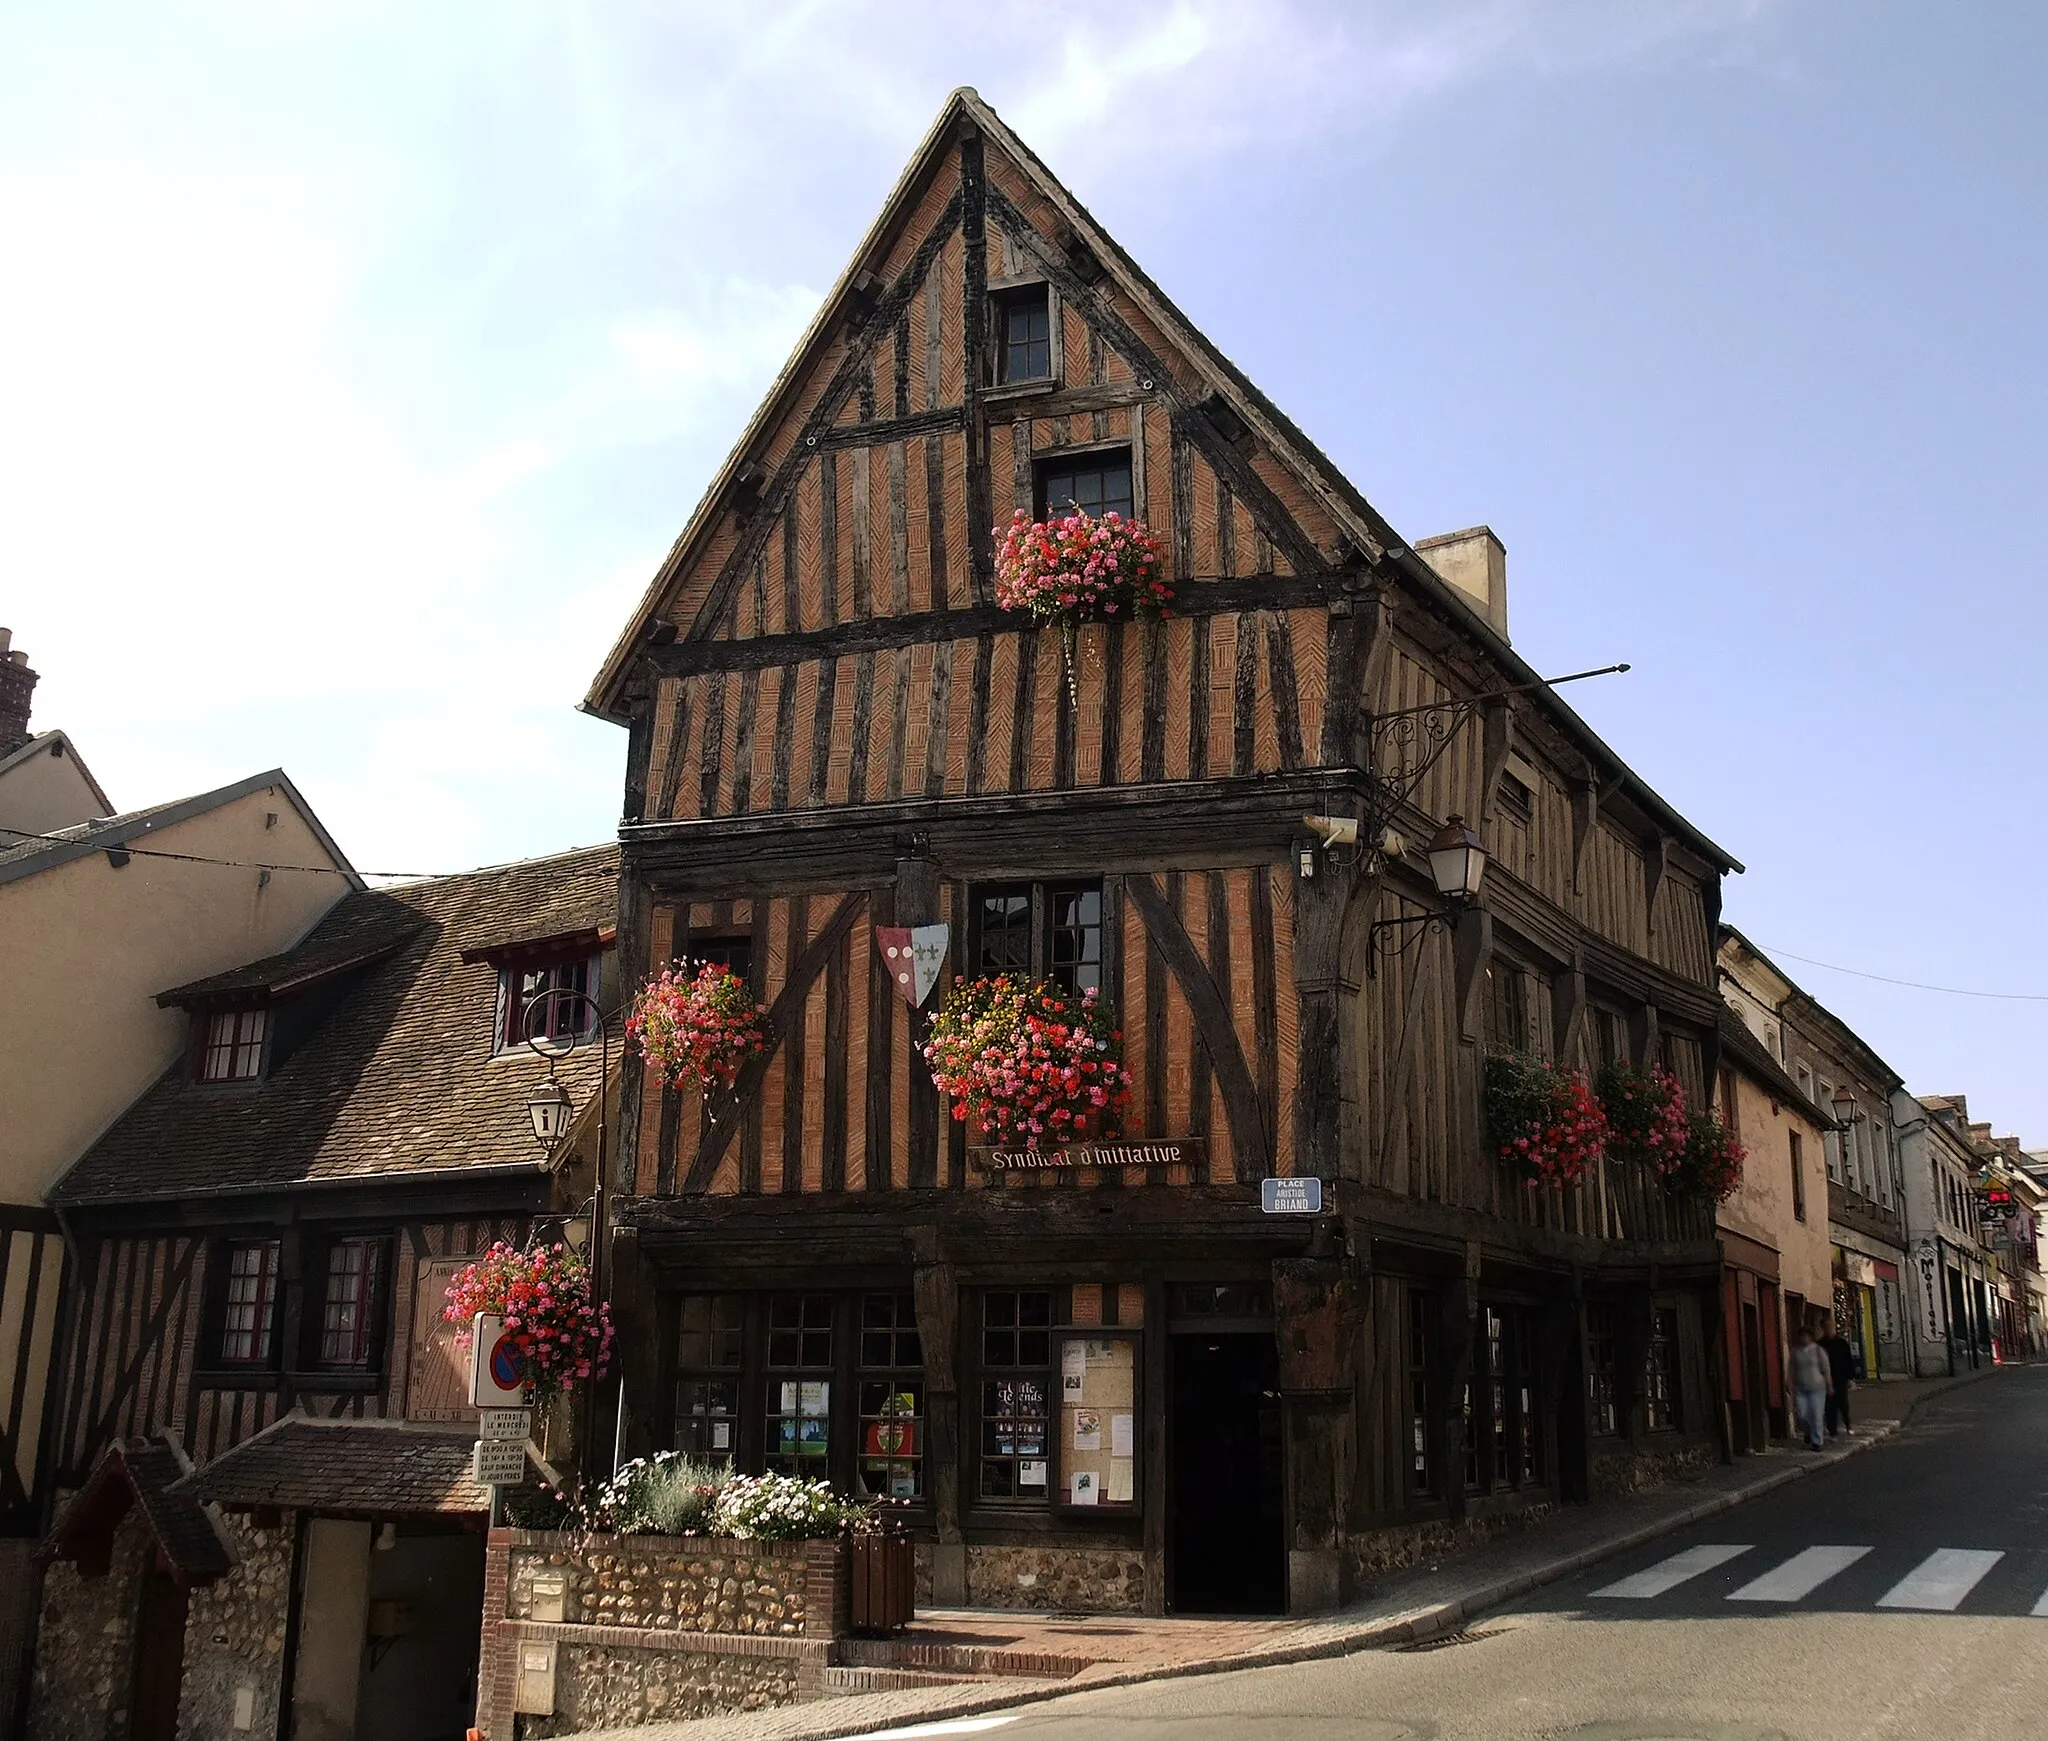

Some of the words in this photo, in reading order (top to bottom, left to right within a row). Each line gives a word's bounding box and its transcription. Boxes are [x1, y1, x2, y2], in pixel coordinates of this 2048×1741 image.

[1276, 1189, 1306, 1198] ARISTIDE
[1274, 1199, 1309, 1210] BRIAND
[495, 1463, 522, 1471] DIMANCHE
